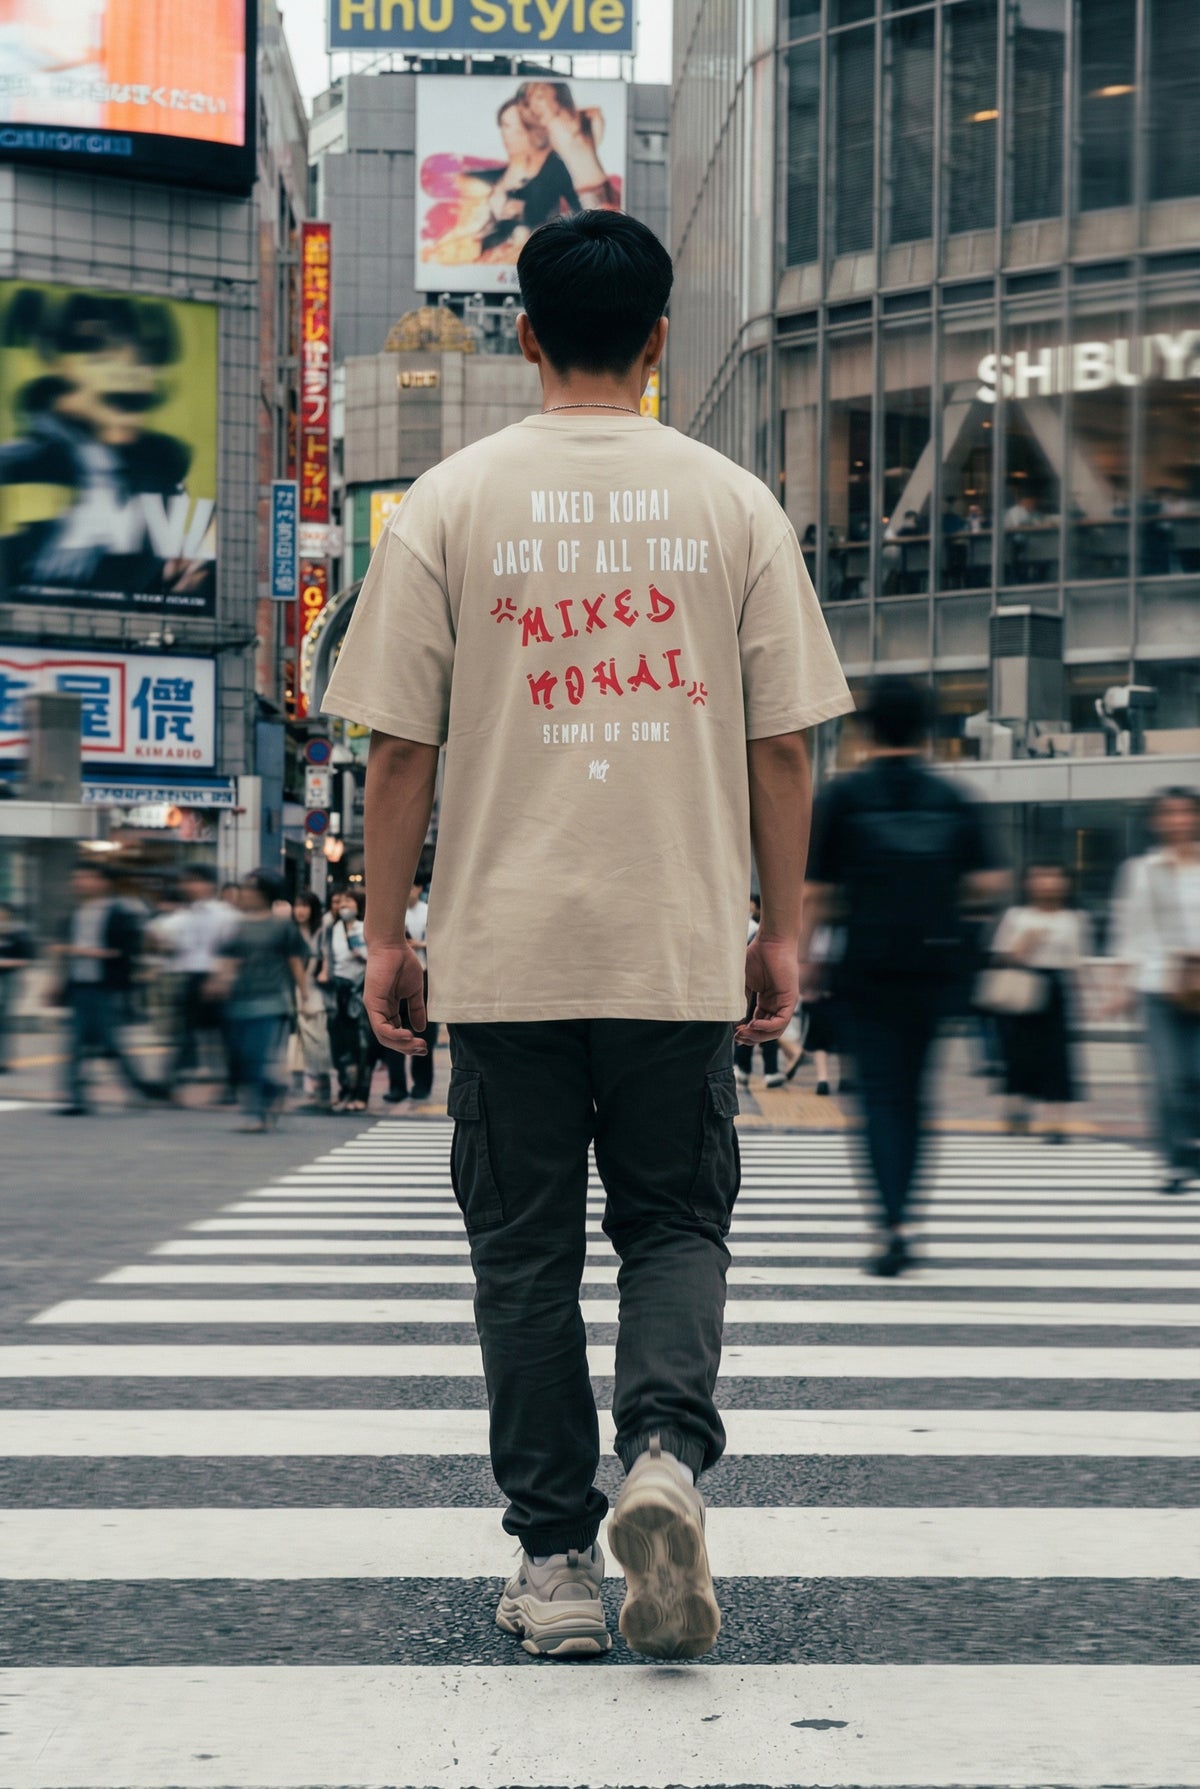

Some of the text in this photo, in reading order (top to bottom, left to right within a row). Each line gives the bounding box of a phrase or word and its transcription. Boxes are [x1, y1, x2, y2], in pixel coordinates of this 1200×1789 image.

[470, 0, 625, 41] Style
[976, 329, 1200, 403] SHIBUY
[531, 489, 669, 523] MIXED KOHAI
[493, 537, 709, 576] JACK OF ALL TRADE
[517, 583, 676, 647] MIXED
[543, 722, 670, 744] SENPAI OF SOME
